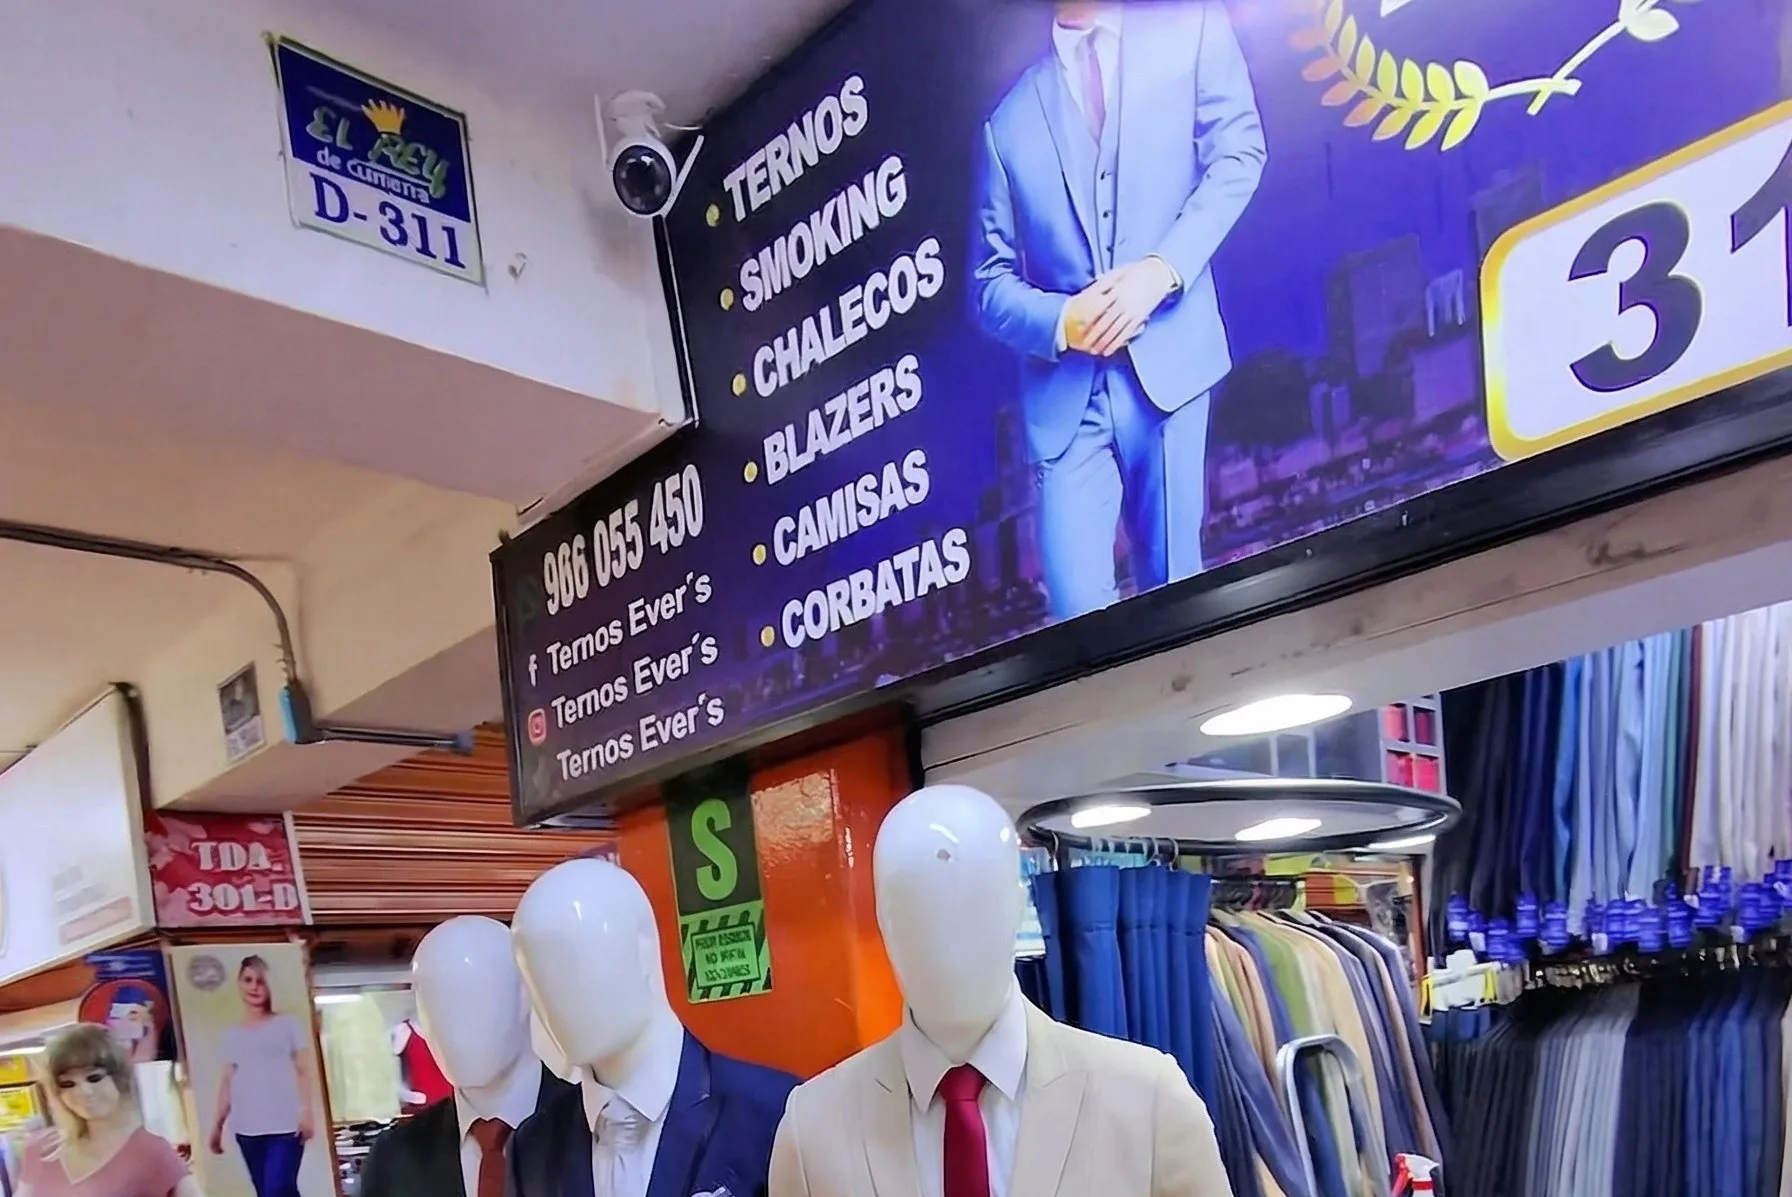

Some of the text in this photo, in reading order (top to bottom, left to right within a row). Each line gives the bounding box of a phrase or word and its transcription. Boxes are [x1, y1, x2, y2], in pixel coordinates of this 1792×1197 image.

[317, 146, 342, 171] de
[723, 75, 868, 222] TERNOS
[739, 156, 907, 312] SMOKING
[752, 237, 945, 398] CHALECOS
[763, 354, 923, 485] BLAZERS
[593, 499, 643, 587] 055
[650, 464, 704, 554] 450
[773, 449, 930, 566] CAMISAS
[546, 619, 624, 675] Ternos
[781, 528, 971, 649] CORBATAS
[551, 675, 628, 729] Ternos
[556, 730, 635, 781] Ternos
[691, 798, 738, 901] S
